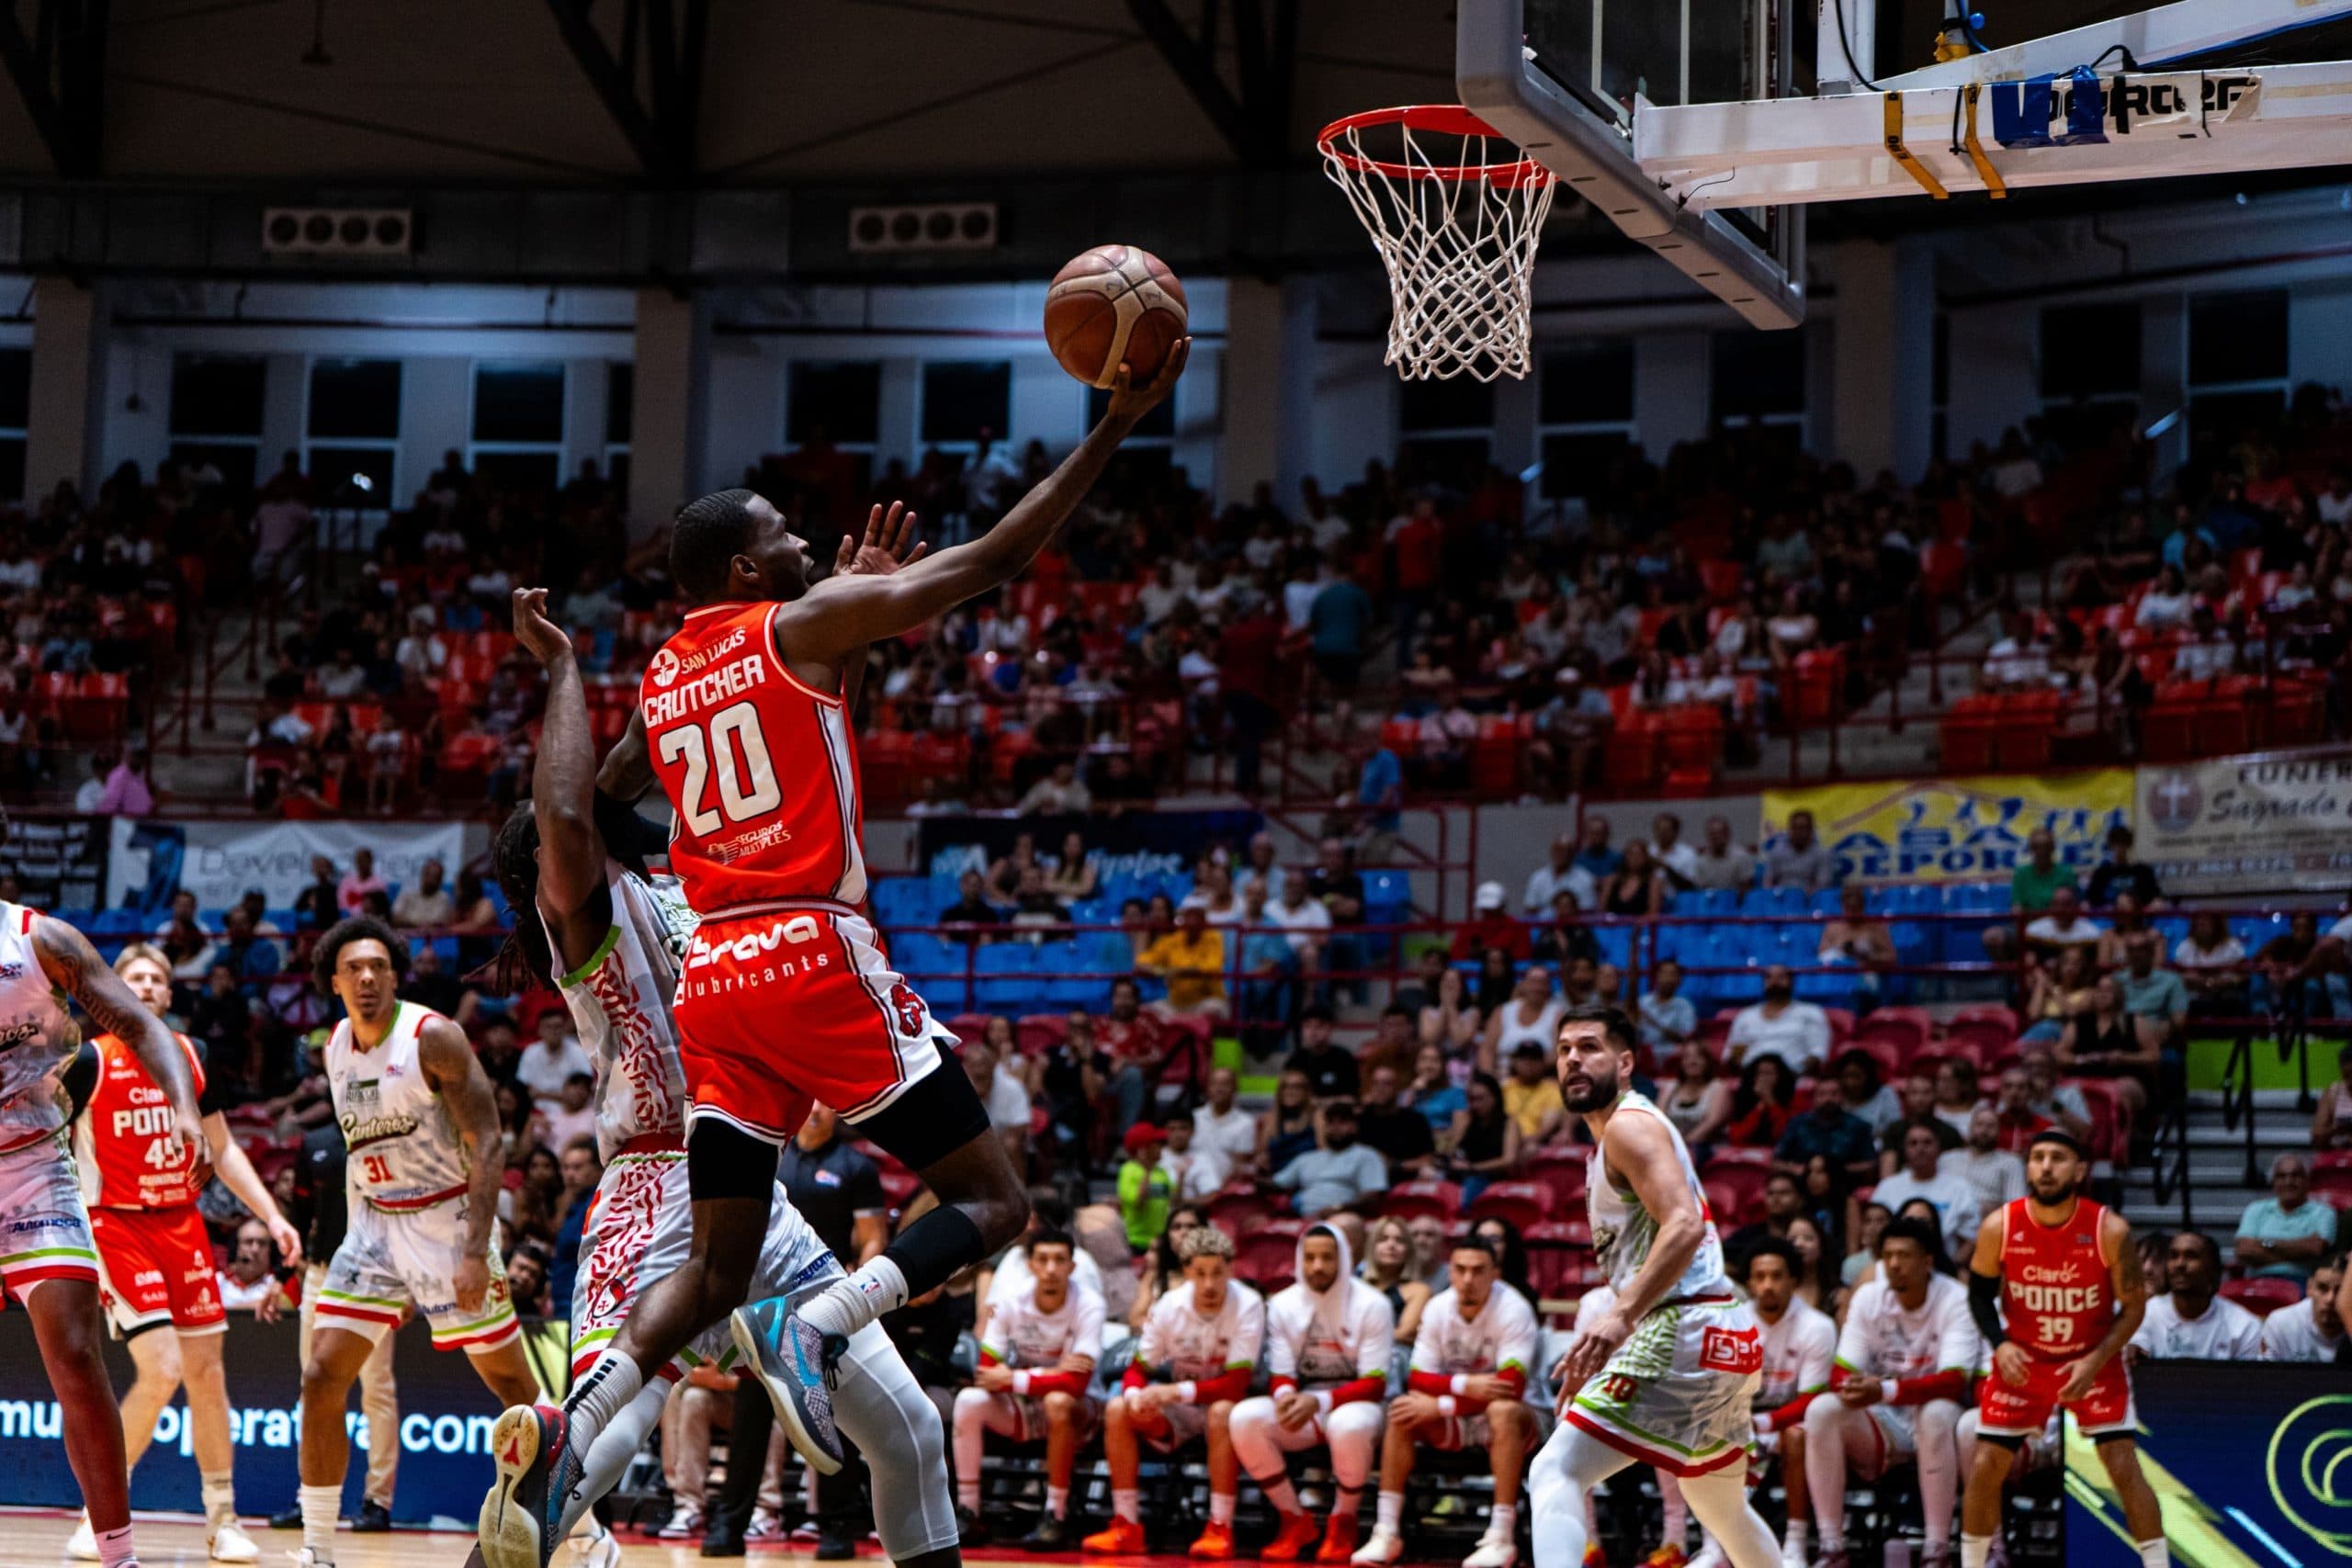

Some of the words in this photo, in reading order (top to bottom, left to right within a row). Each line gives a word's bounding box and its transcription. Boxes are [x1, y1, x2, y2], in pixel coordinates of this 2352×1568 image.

[681, 652, 707, 674] SAN
[707, 629, 746, 663] LUCAS
[644, 654, 765, 728] CRUTCHER
[659, 701, 782, 838] 20
[735, 820, 783, 845] SEGUROS
[690, 916, 820, 969] brava
[688, 953, 829, 998] lubricants
[129, 1087, 165, 1104] Clar
[113, 1105, 176, 1137] PON
[364, 1155, 394, 1183] 31
[2022, 1263, 2076, 1283] Claro
[2008, 1280, 2100, 1313] PONCE
[2036, 1315, 2074, 1343] 39
[1602, 1372, 1638, 1403] 10
